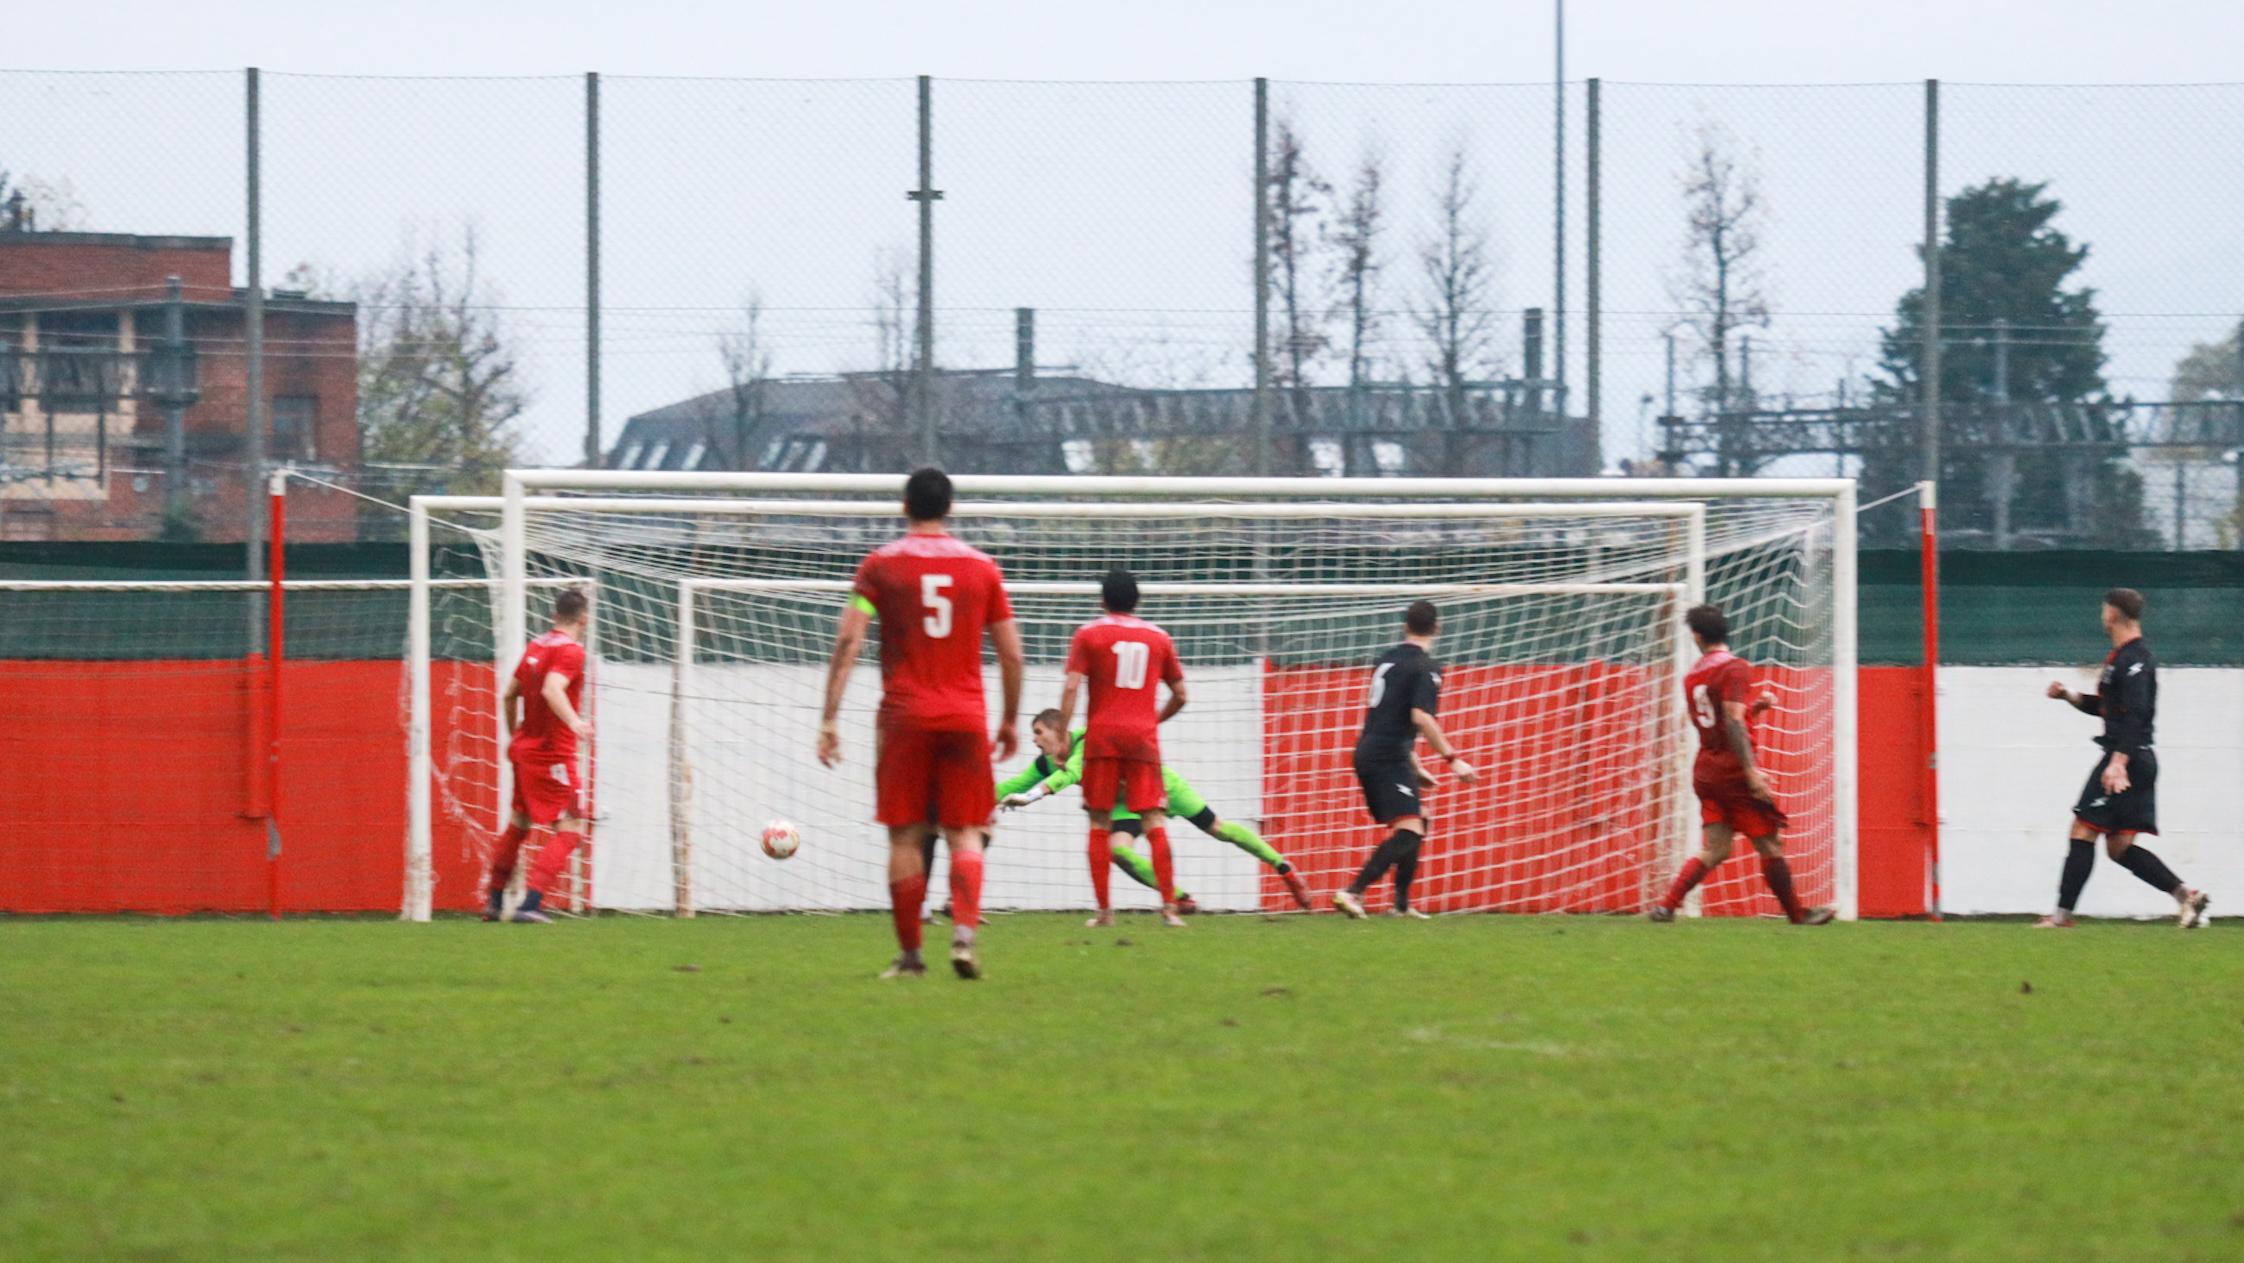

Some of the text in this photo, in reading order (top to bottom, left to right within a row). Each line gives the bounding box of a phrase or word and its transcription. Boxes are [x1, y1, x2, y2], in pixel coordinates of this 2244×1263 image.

[920, 573, 953, 639] 5
[1111, 640, 1150, 690] 10
[1692, 683, 1716, 729] 9
